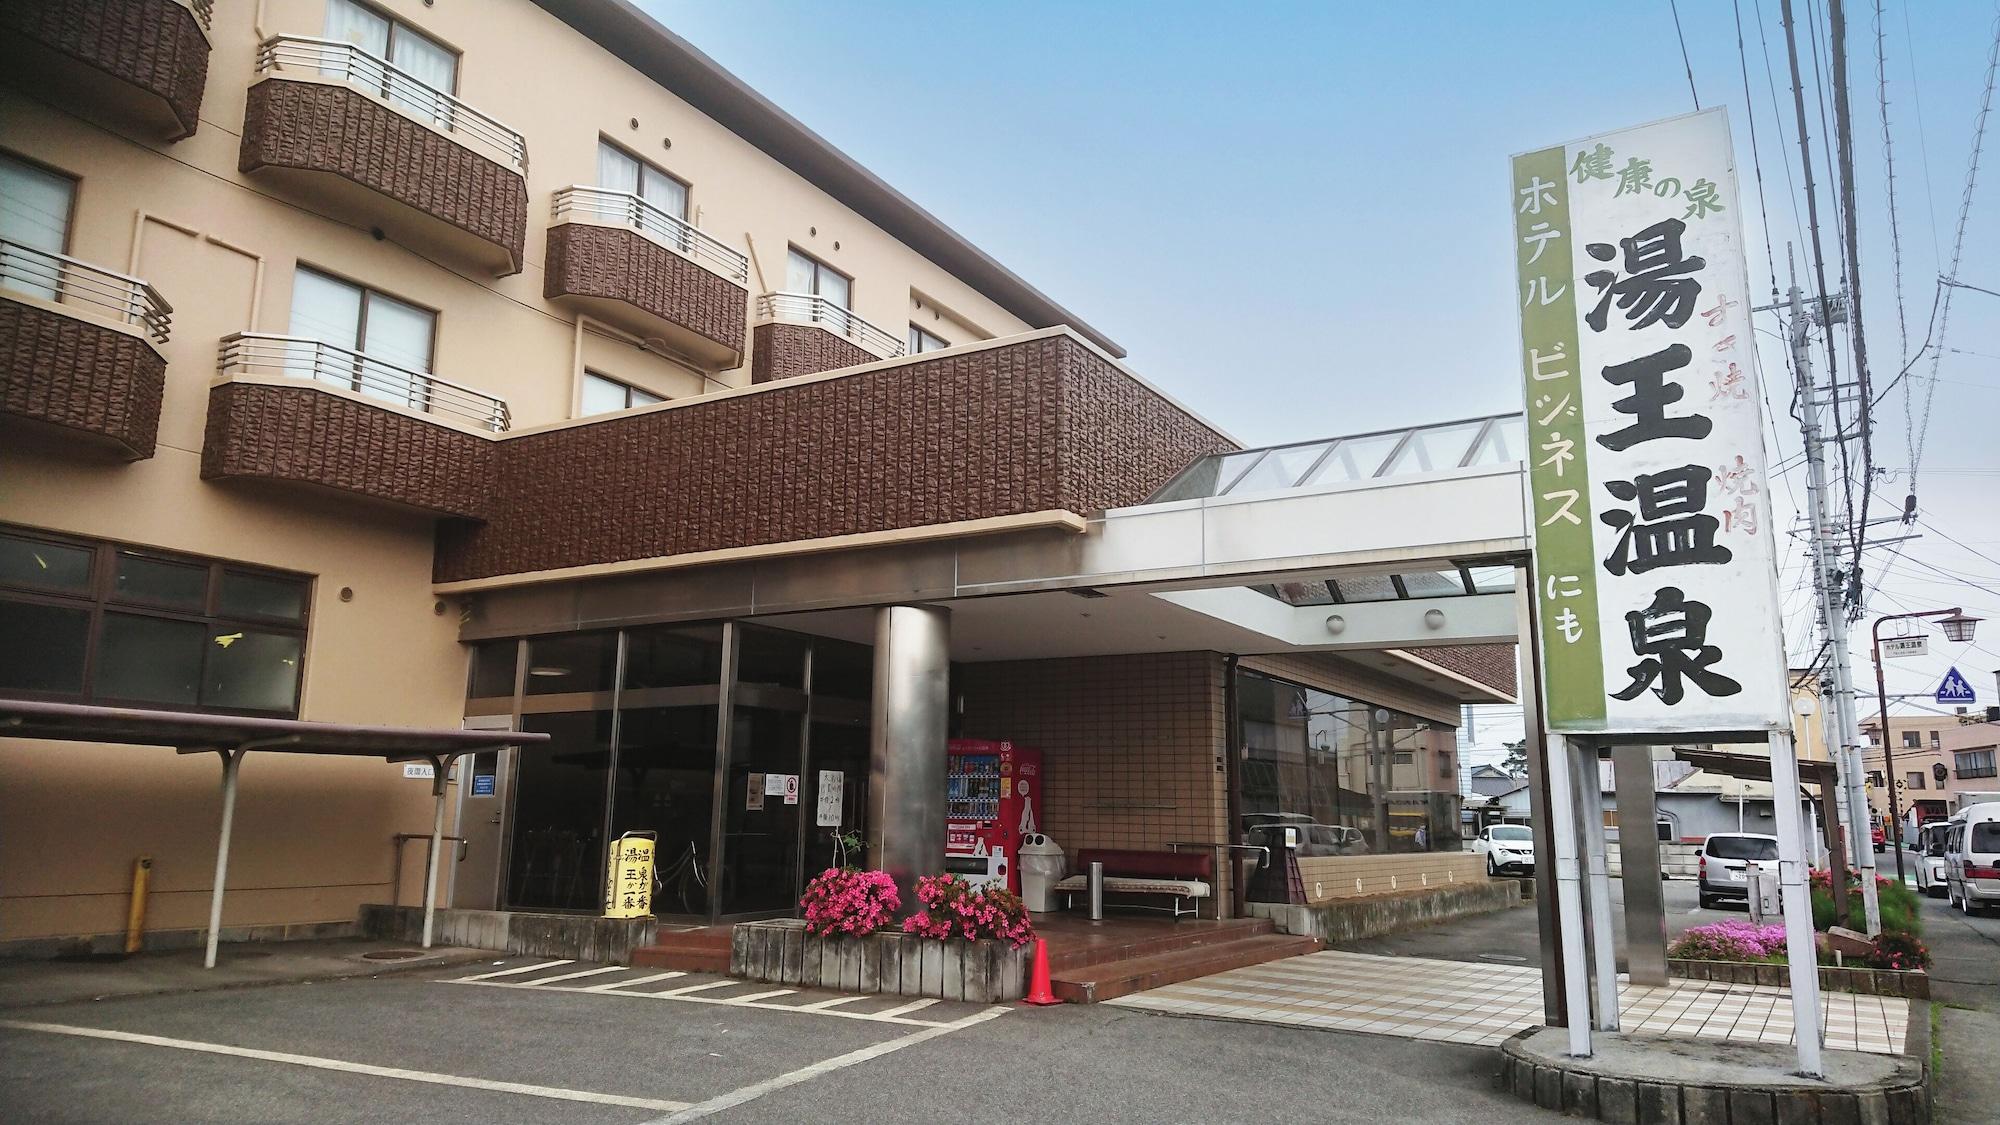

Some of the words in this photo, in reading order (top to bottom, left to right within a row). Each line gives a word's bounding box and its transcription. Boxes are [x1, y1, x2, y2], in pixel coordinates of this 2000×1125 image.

[1569, 142, 1726, 220] 健康の泉
[1519, 176, 1567, 309] ホテル
[1530, 341, 1582, 527] ビジネス
[1583, 217, 1742, 706] 湯王温泉
[1715, 454, 1760, 535] 焼肉
[1546, 574, 1583, 644] にも
[623, 848, 638, 909] 湯王が一番
[636, 848, 649, 909] 温泉が一番
